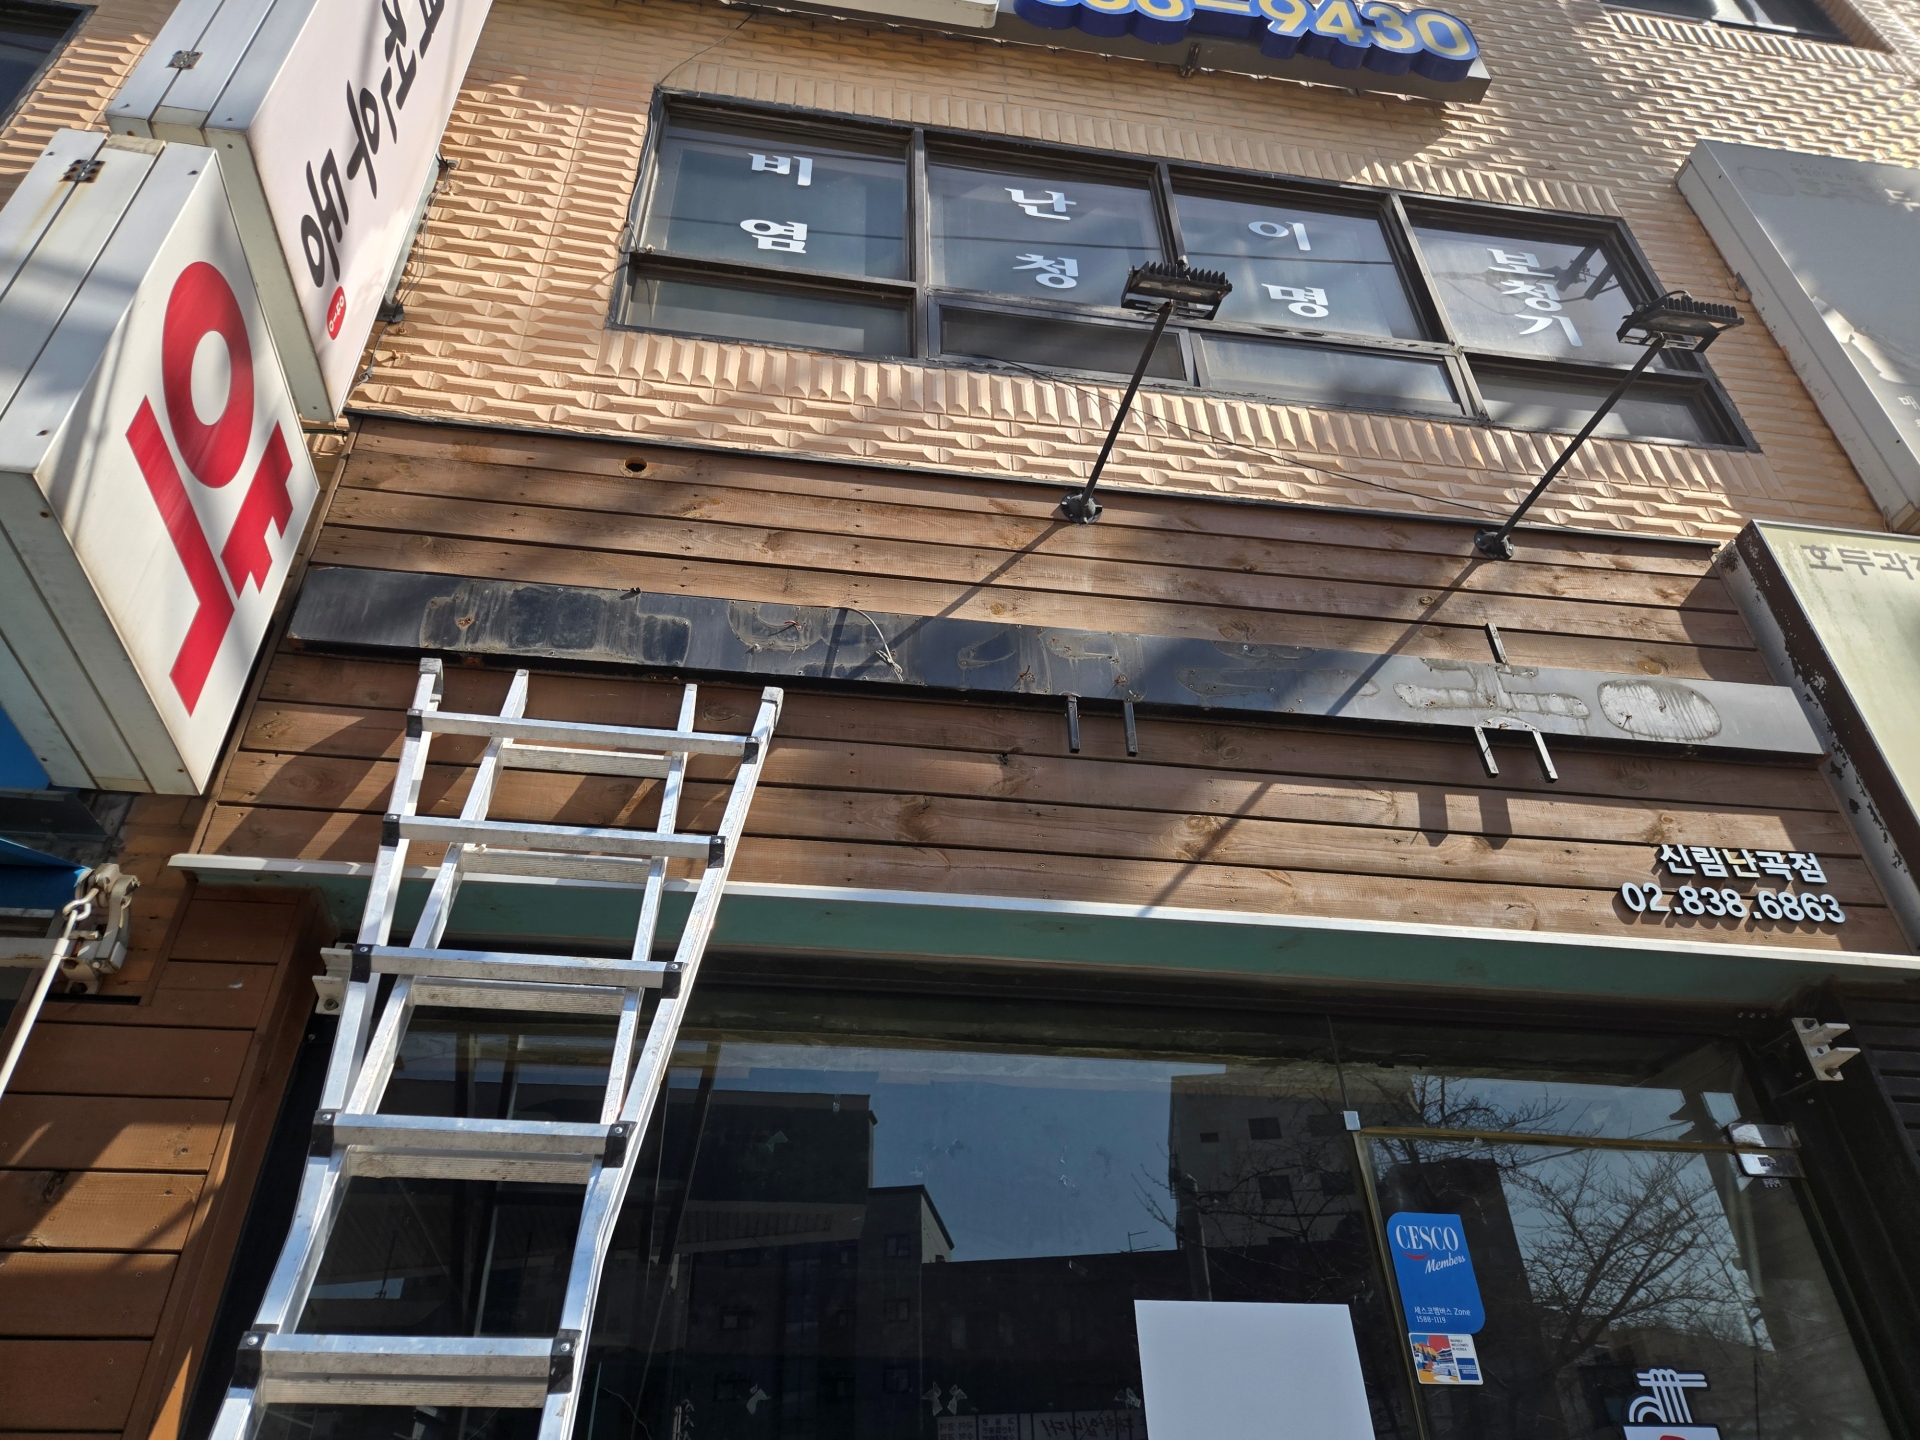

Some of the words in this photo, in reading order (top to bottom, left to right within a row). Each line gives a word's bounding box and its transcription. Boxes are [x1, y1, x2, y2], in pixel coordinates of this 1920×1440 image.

[300, 0, 446, 288] 전우동
[739, 152, 814, 254] 비염
[1005, 187, 1078, 289] 난청
[1248, 220, 1330, 318] 이명
[1487, 248, 1583, 347] 보청기
[125, 261, 294, 718] 약
[1621, 881, 1846, 924] 02.838.6863
[1659, 844, 1827, 884] 신림난곡점
[1395, 1224, 1459, 1252] CESCO
[1424, 1252, 1466, 1274] Members
[1454, 1306, 1471, 1317] Zone
